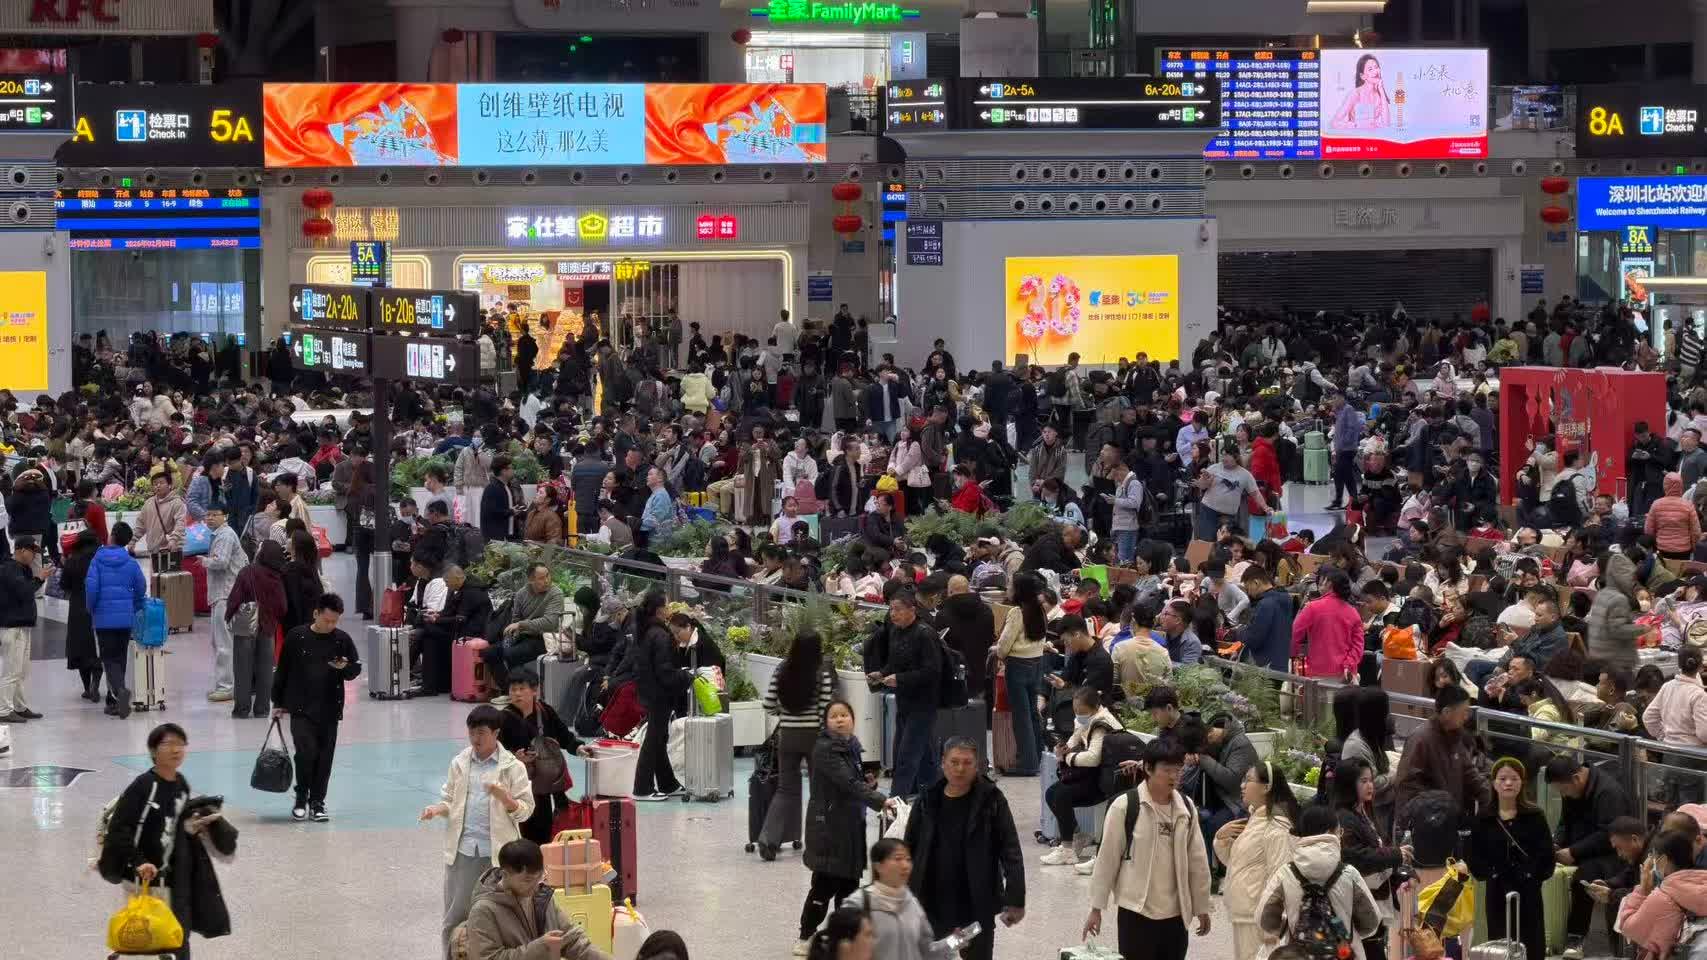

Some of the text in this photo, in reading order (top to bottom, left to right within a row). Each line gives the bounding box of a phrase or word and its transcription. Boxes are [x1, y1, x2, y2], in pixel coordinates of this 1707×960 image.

[812, 3, 899, 24] FamilyMart
[1003, 84, 1035, 96] 2A-5A
[1145, 83, 1182, 96] 6A-20A
[478, 91, 625, 119] 创维壁纸电视
[148, 113, 190, 128] 检票口
[1589, 106, 1625, 136] 8A
[1665, 109, 1697, 123] 检票口
[210, 109, 254, 142] 5A
[1665, 123, 1687, 132] Check
[149, 130, 176, 139] Check
[1609, 183, 1707, 203] 深圳北站欢迎
[1595, 207, 1627, 216] Welcome
[1680, 206, 1706, 216] Railway
[609, 214, 665, 237] 超市
[1629, 229, 1648, 244] 8A
[357, 247, 375, 262] 5A
[557, 261, 611, 274] 港澳台广东
[326, 293, 358, 320] 2A-20A
[379, 297, 415, 325] 1B-20B
